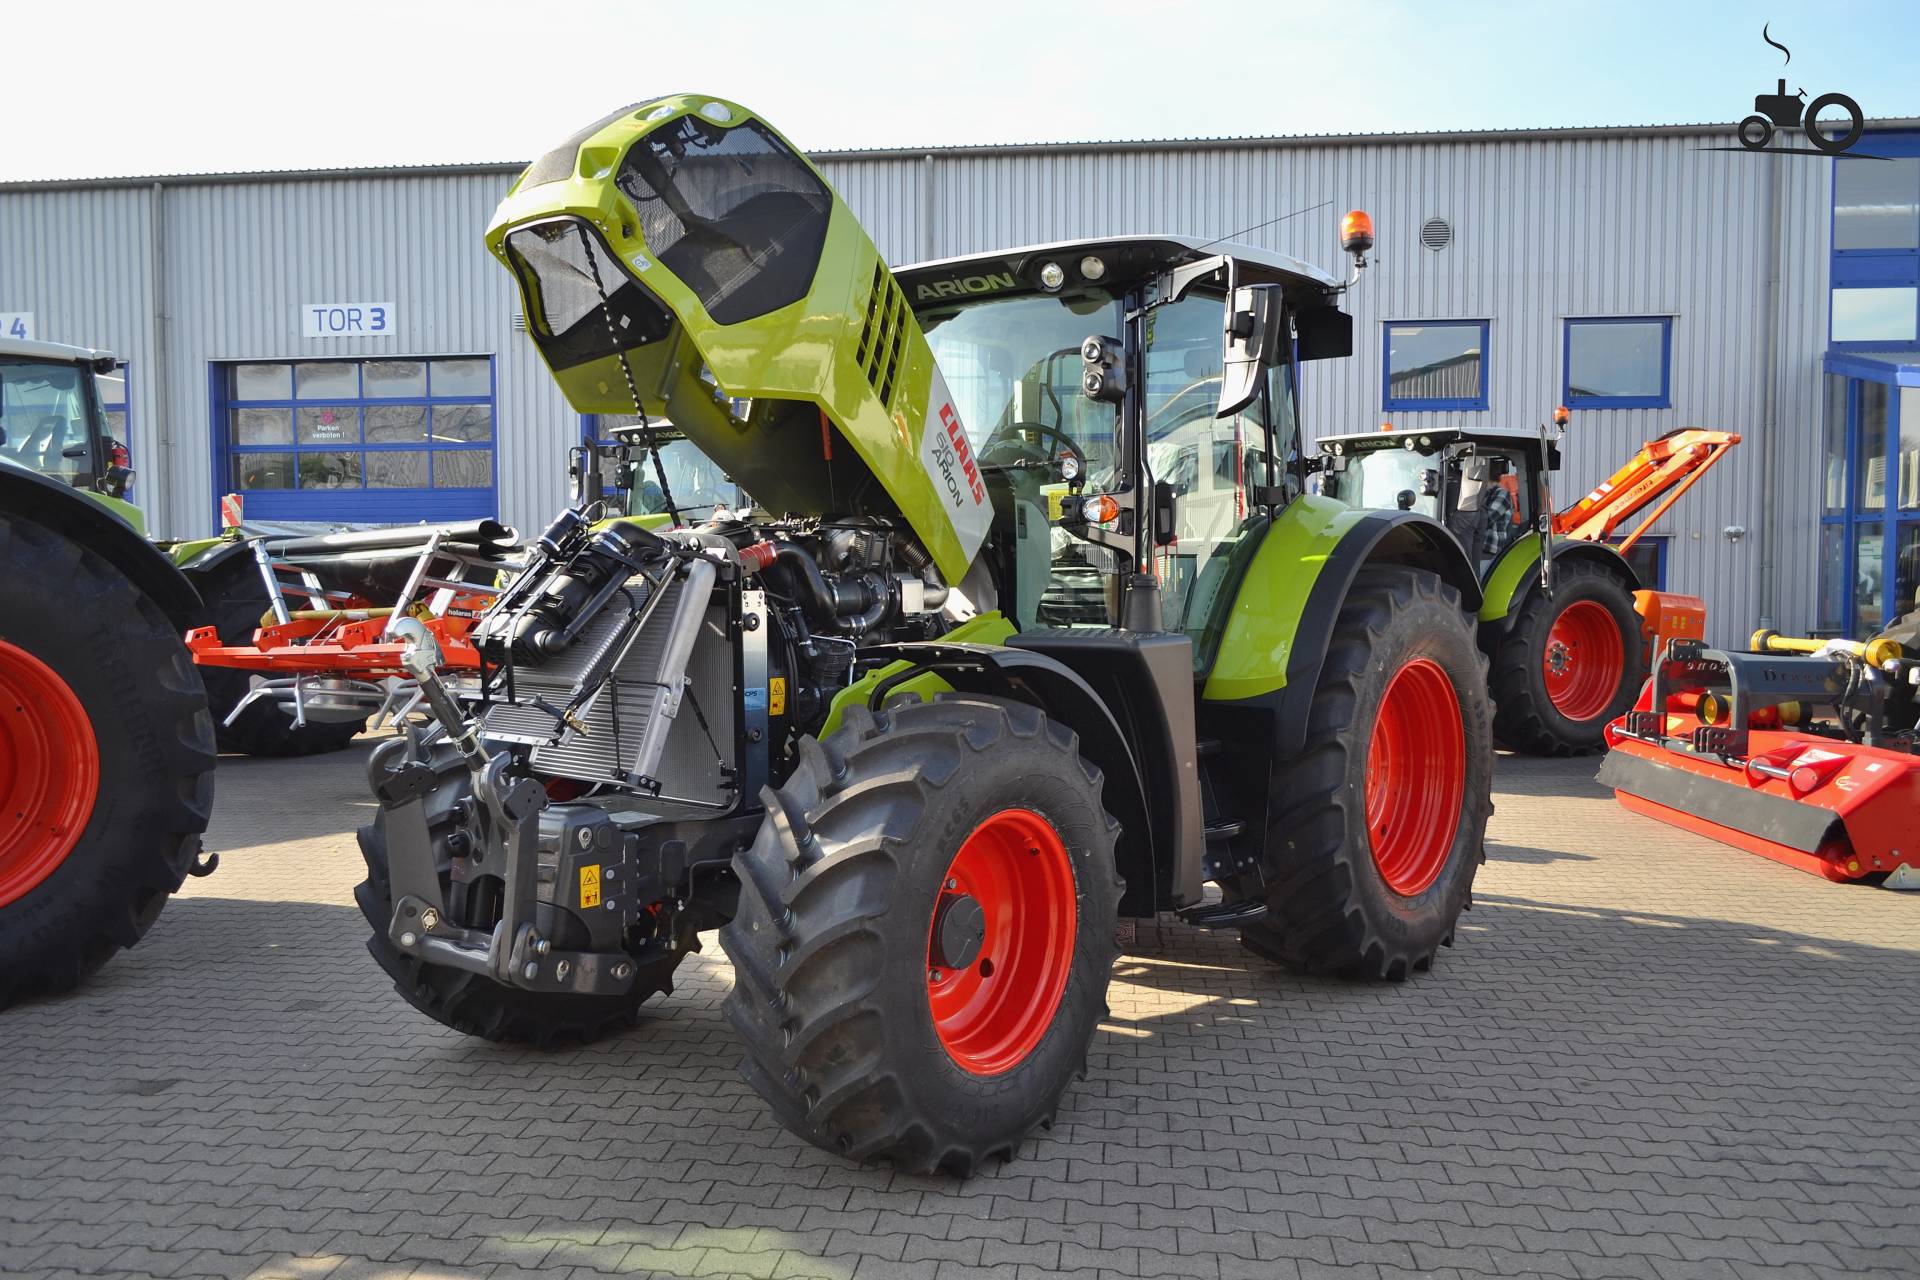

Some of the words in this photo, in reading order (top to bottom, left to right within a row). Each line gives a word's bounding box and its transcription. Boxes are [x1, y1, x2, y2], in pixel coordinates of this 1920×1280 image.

[917, 272, 1016, 299] ARION
[10, 317, 27, 339] 4
[312, 308, 362, 331] TOR
[370, 307, 386, 331] 3
[312, 431, 341, 439] verboten
[935, 431, 955, 468] 610
[938, 402, 985, 507] CLAAS
[931, 448, 964, 508] ARION
